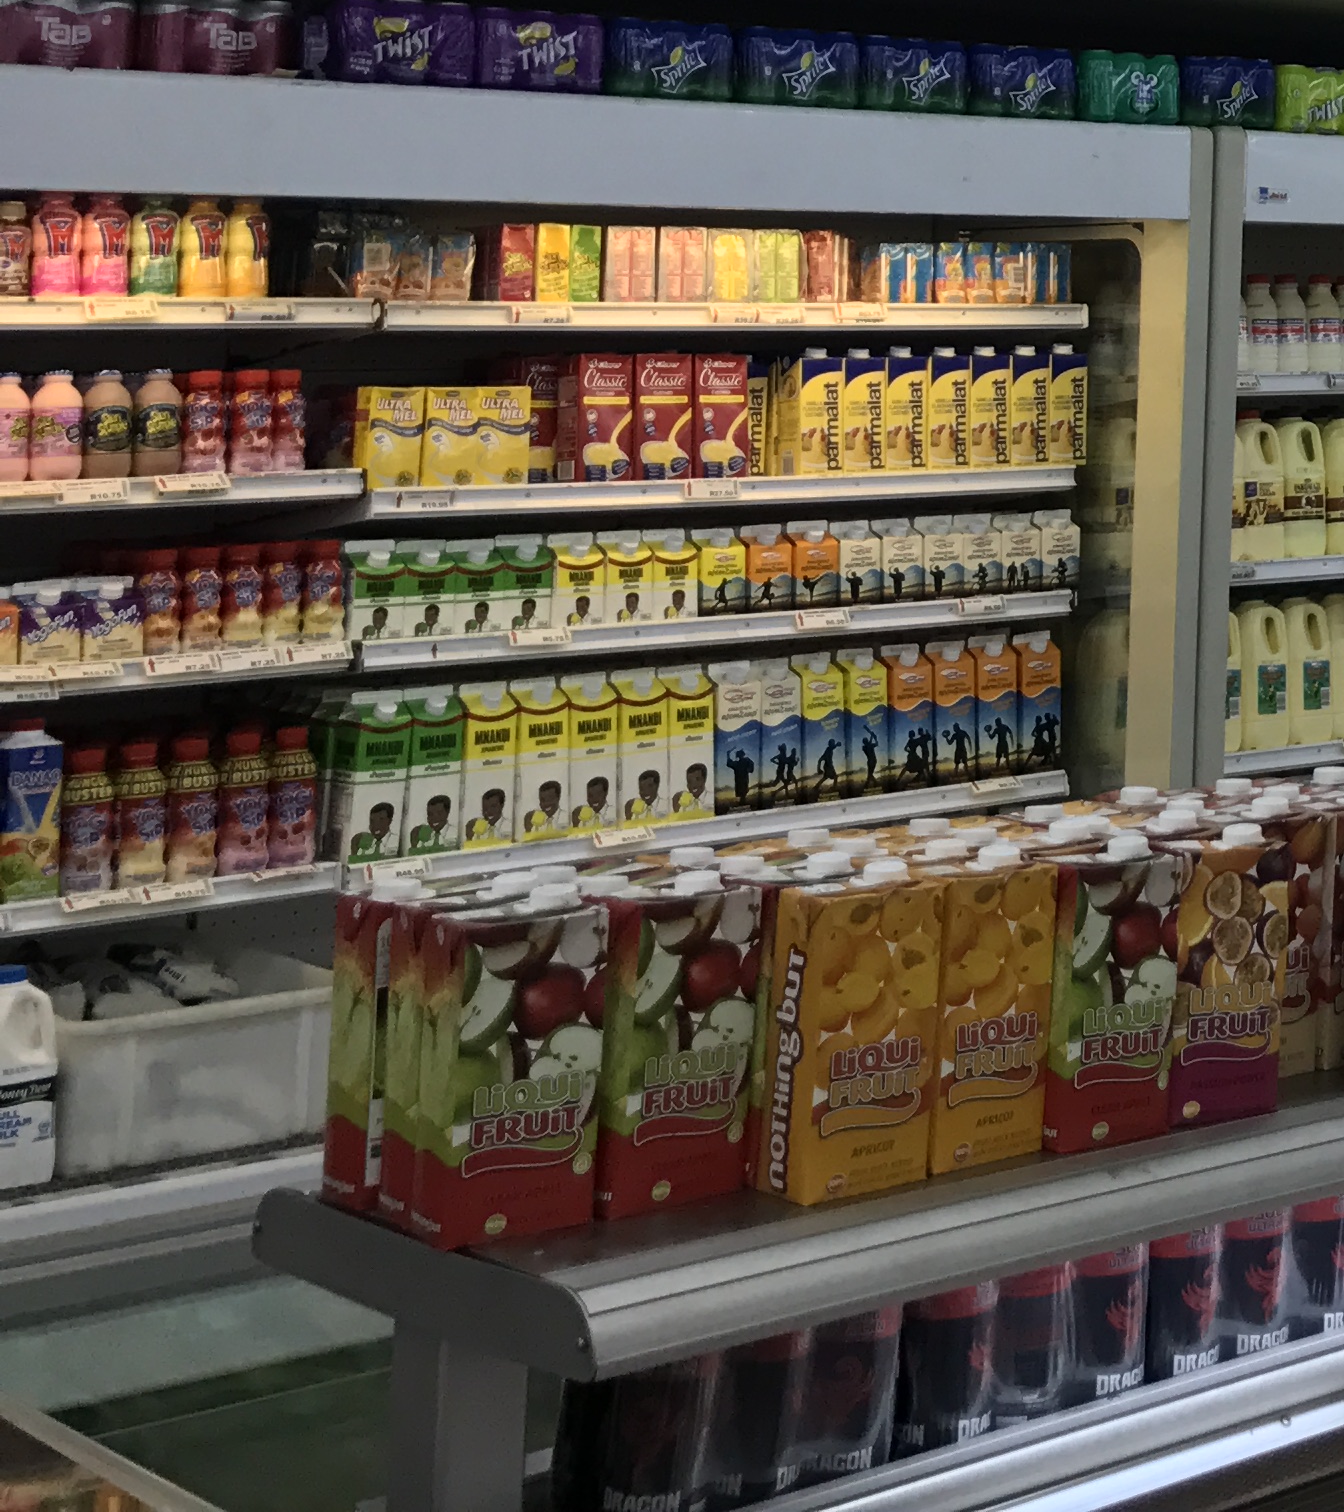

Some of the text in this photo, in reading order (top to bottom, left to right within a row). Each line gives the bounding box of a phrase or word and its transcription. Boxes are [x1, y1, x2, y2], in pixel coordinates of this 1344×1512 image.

[584, 365, 628, 388] Classic
[640, 365, 687, 388] Classic
[699, 365, 742, 388] Classic
[376, 397, 411, 411] ULTRA
[432, 398, 467, 411] ULTRA
[449, 408, 474, 421] MEL
[481, 397, 520, 409] ULTRA
[499, 407, 525, 420] MEL
[392, 408, 418, 422] MEL
[823, 381, 842, 471] parmalat
[866, 380, 882, 470] parmalat
[907, 379, 926, 468] parmalat
[951, 377, 969, 467] parmalat
[992, 377, 1010, 465] parmalat
[1032, 376, 1050, 464] parmalat
[1070, 375, 1086, 462] parmalat
[748, 386, 765, 478] parmalat
[0, 1116, 32, 1130] REAM
